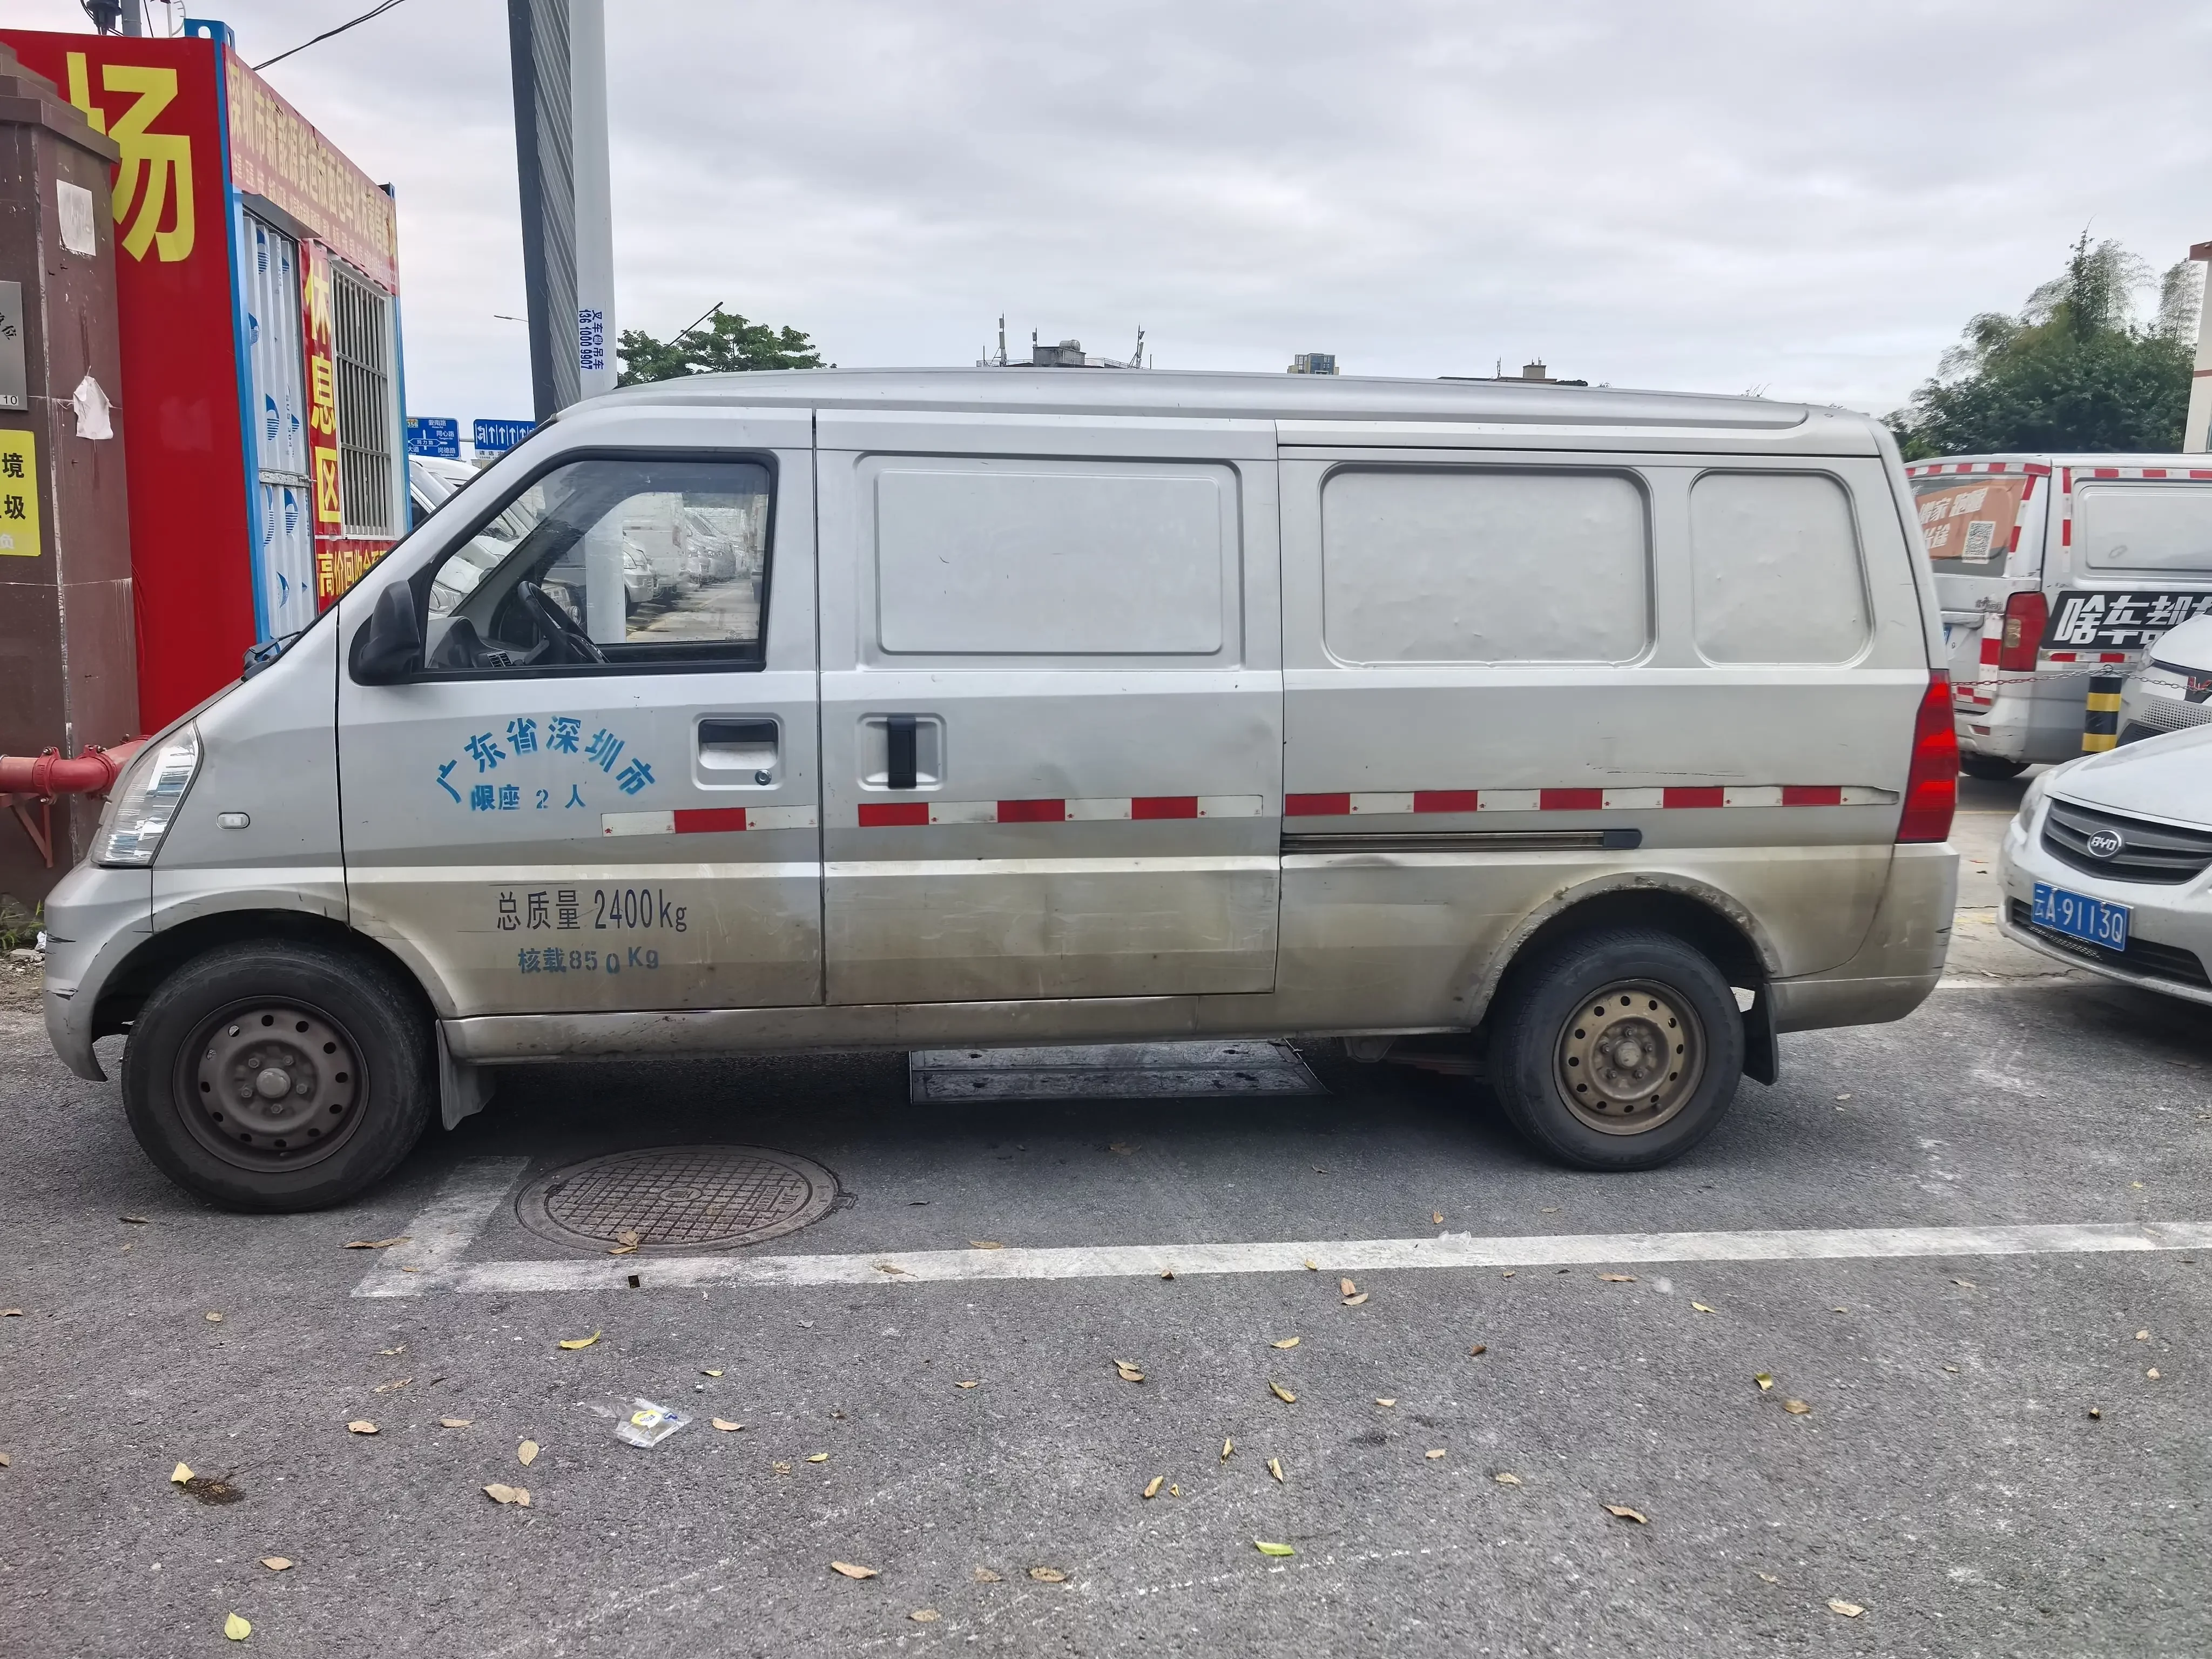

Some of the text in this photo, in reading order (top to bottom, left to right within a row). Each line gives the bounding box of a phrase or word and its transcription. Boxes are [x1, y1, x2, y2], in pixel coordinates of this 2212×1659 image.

[579, 309, 593, 369] 136 1000 9907
[304, 257, 341, 523] 休息区
[2, 453, 24, 478] 境
[436, 716, 656, 804] 广东省深圳市
[2091, 835, 2117, 851] BYD
